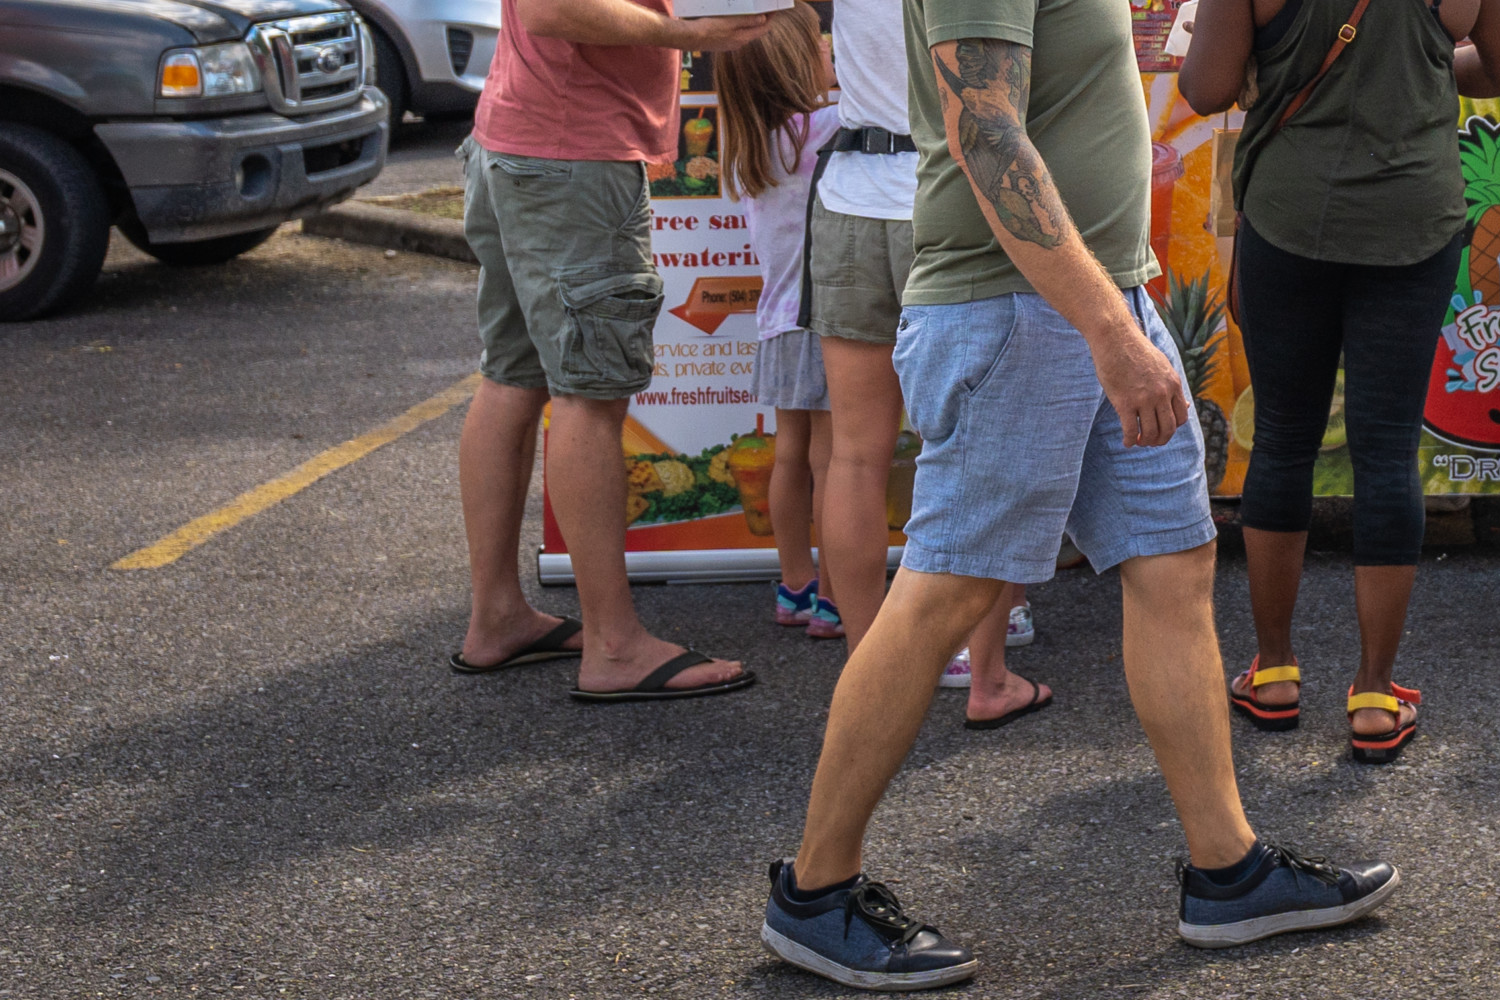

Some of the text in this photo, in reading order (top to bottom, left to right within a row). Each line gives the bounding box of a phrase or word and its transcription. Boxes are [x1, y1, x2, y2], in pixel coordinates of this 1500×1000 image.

[652, 341, 758, 357] ervice and las
[675, 361, 726, 378] private
